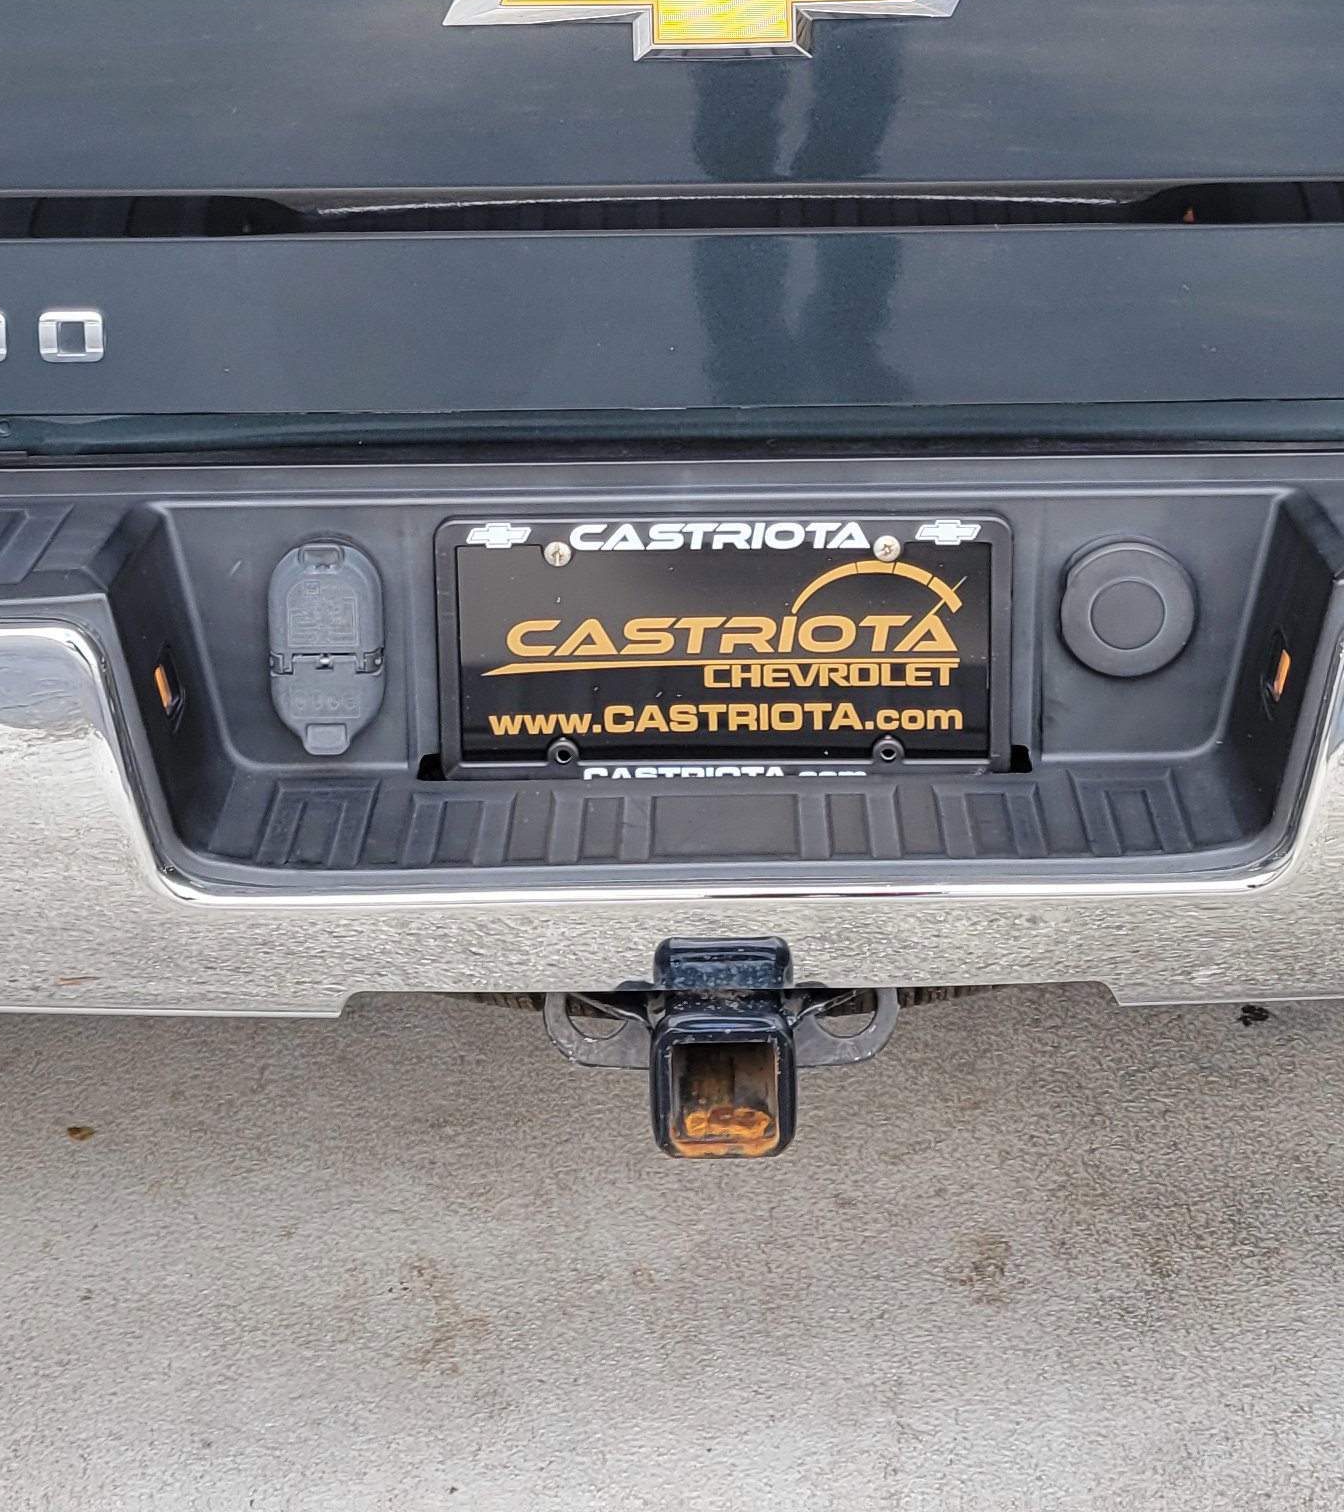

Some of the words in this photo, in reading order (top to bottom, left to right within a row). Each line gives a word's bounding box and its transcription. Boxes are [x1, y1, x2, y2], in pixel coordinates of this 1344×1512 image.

[569, 522, 870, 551] CASTRIOTA
[506, 614, 959, 657] CASTRIOTA
[703, 662, 959, 689] CHEVROLET
[488, 702, 964, 736] www.CASTRIOTA.com
